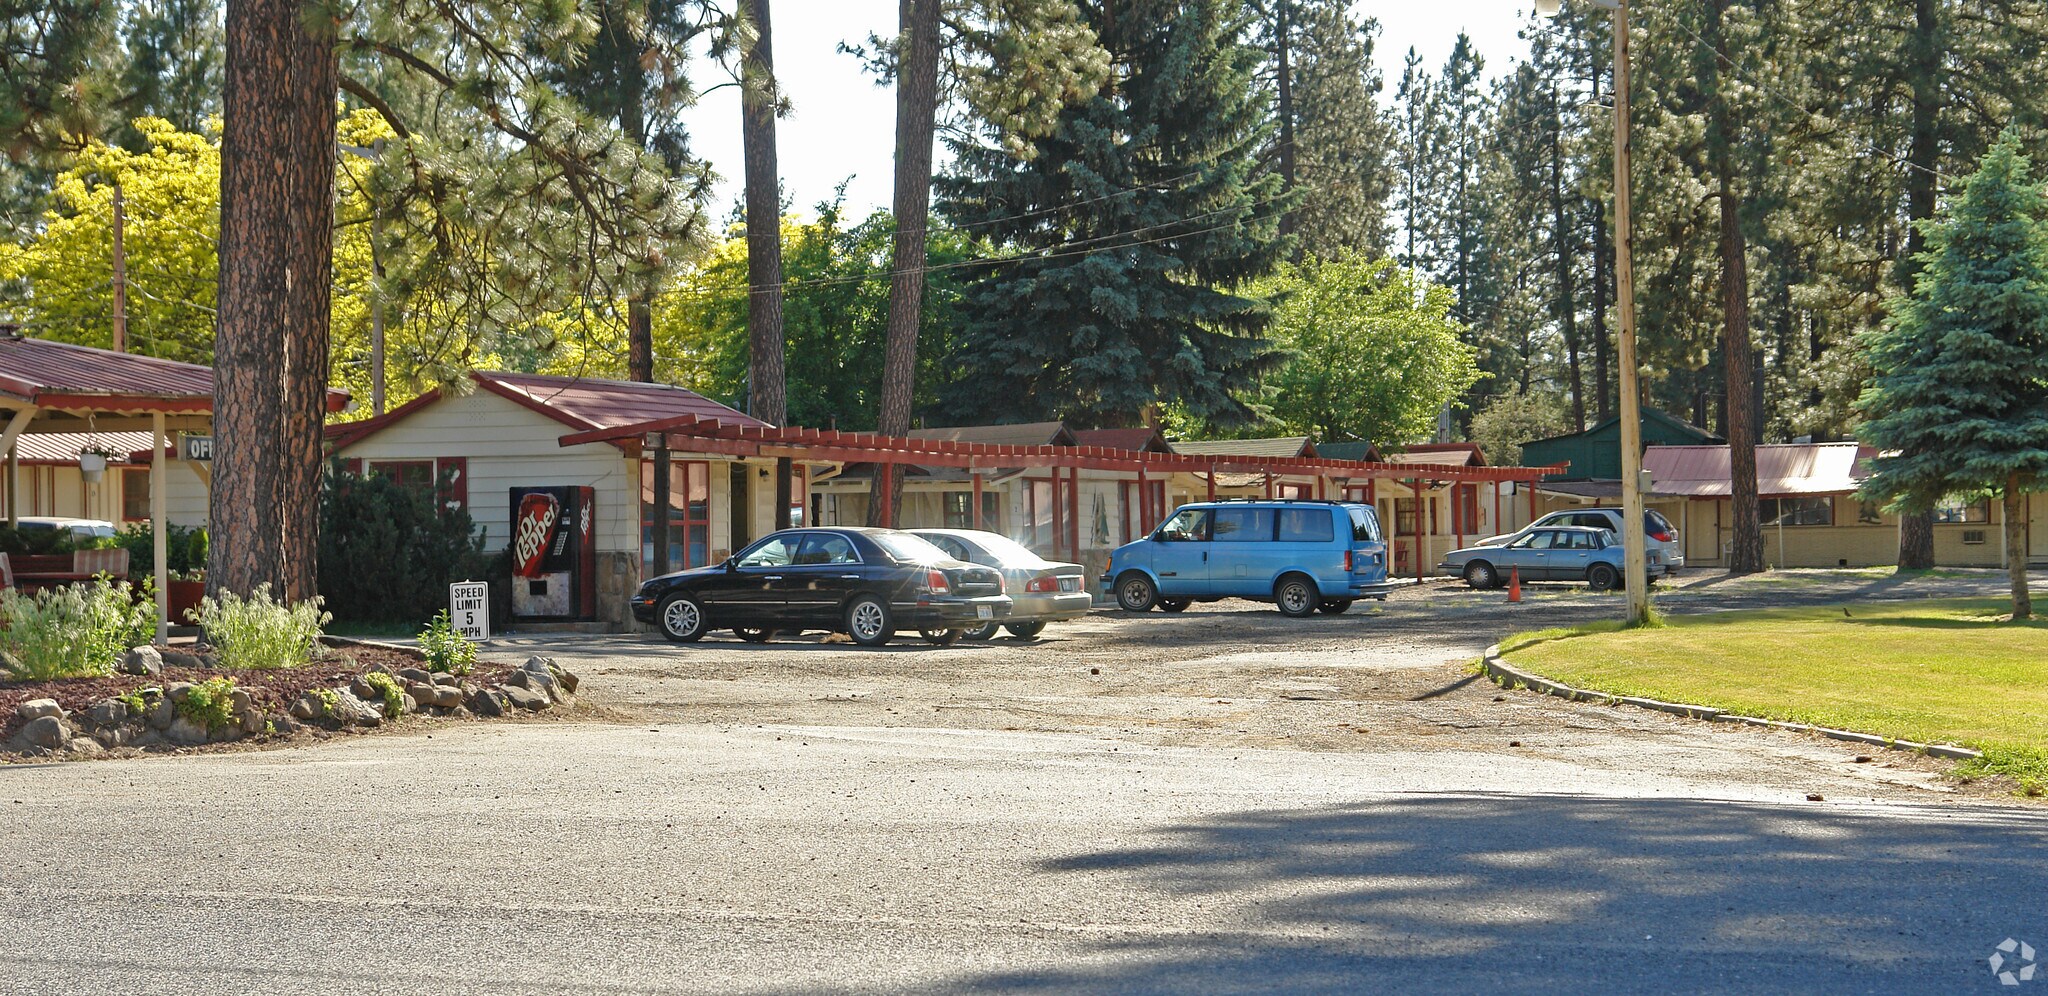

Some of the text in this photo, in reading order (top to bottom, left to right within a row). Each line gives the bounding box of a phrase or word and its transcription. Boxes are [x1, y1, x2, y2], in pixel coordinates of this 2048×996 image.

[520, 510, 538, 541] Dr
[516, 503, 556, 570] Pepper
[454, 587, 484, 599] SPEED
[456, 599, 482, 610] LIMIT
[466, 611, 474, 625] 5
